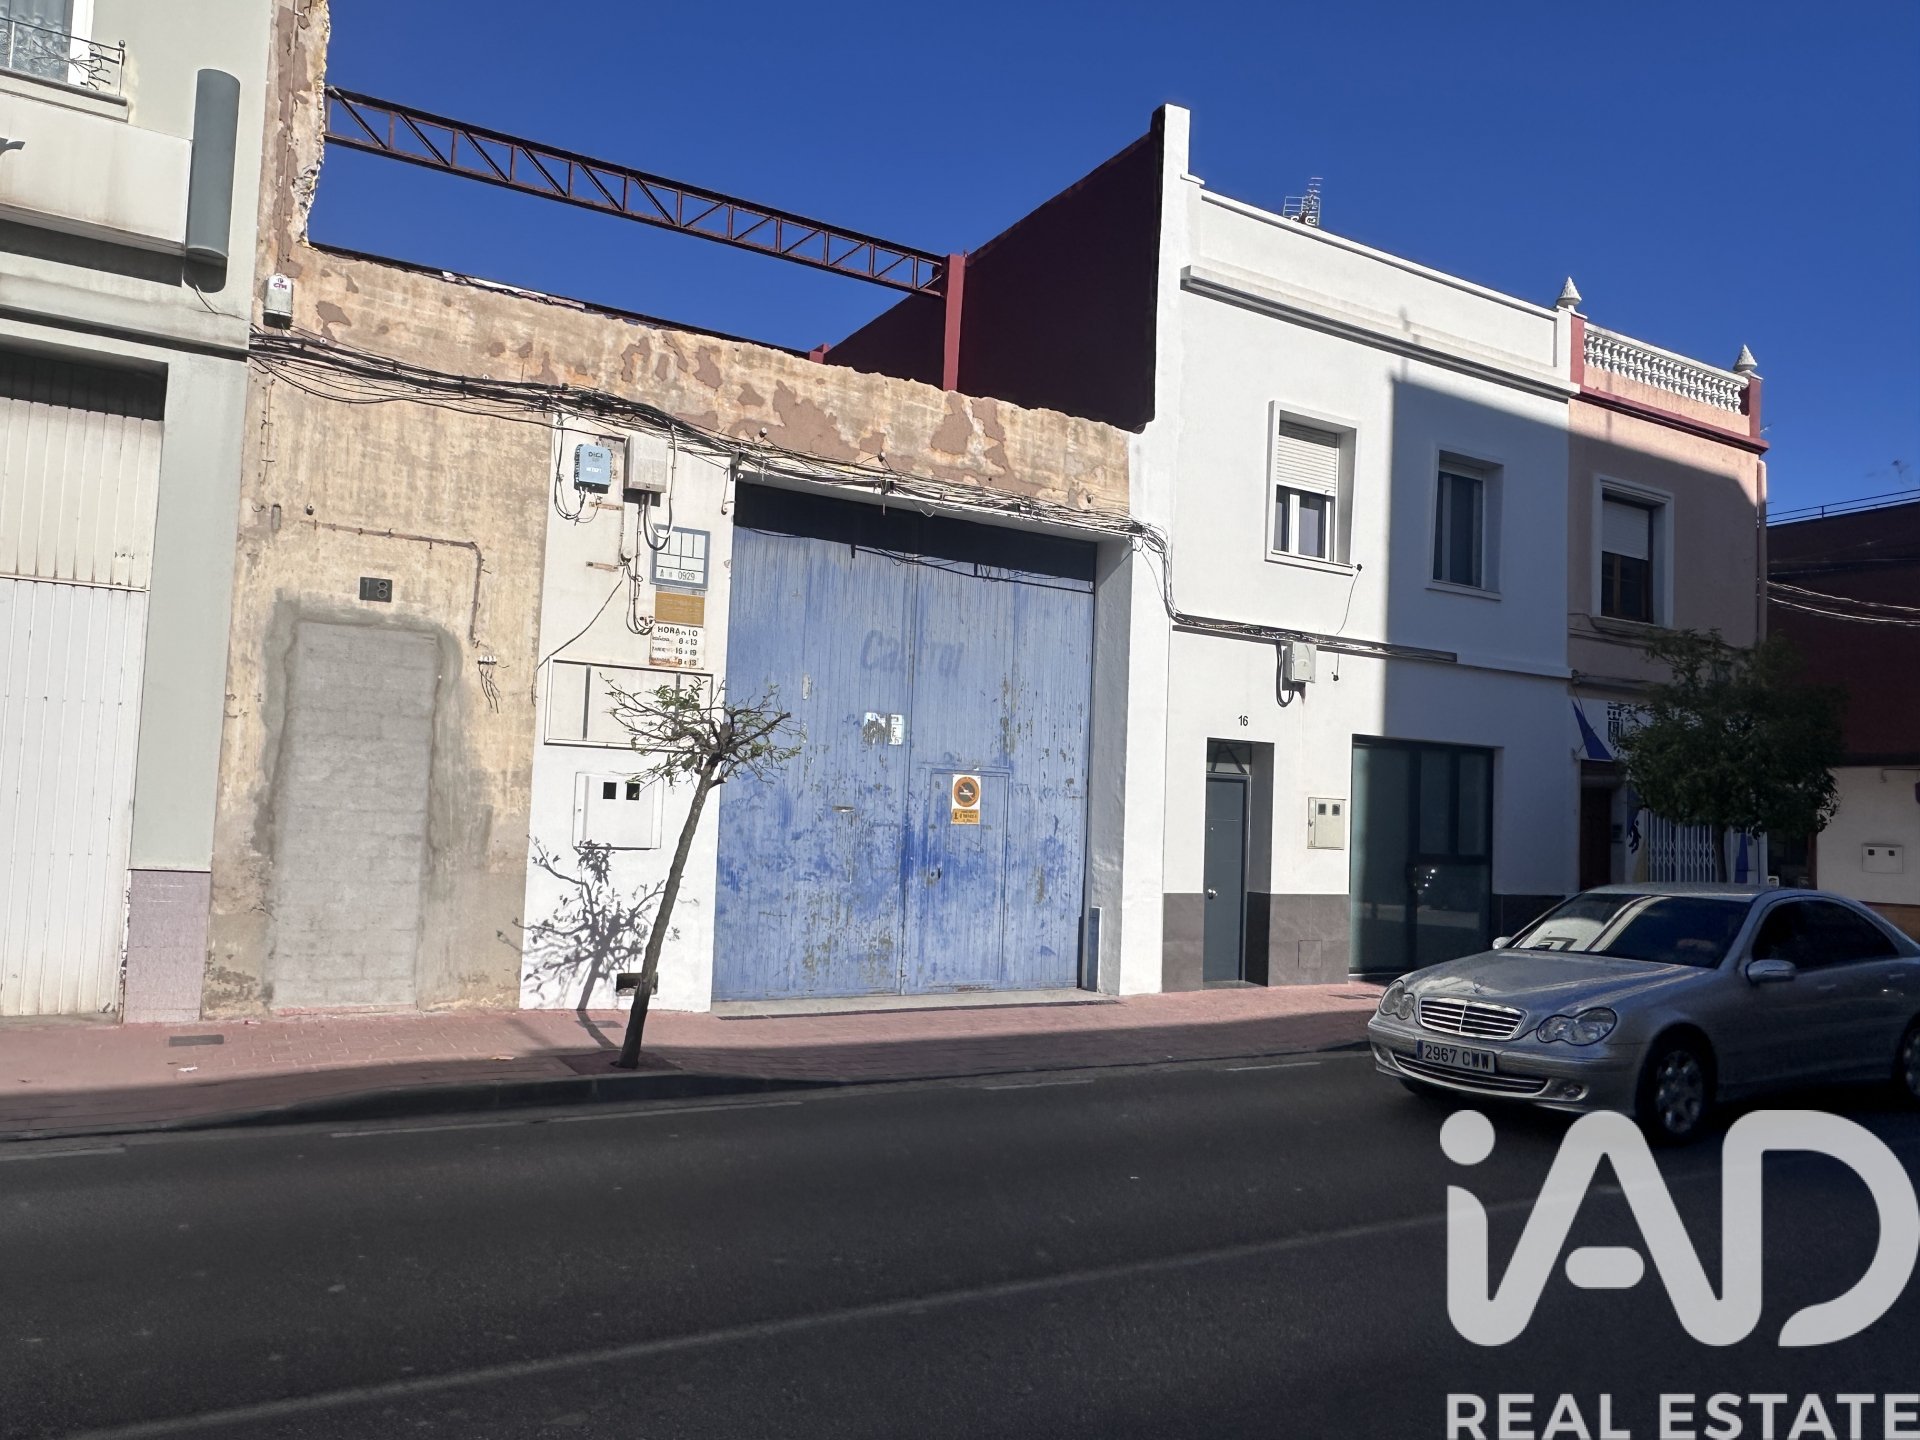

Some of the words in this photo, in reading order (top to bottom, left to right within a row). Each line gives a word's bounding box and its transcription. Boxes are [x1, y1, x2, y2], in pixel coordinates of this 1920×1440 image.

[364, 579, 388, 599] 18
[1238, 714, 1249, 727] 16
[1425, 1044, 1458, 1064] 2967
